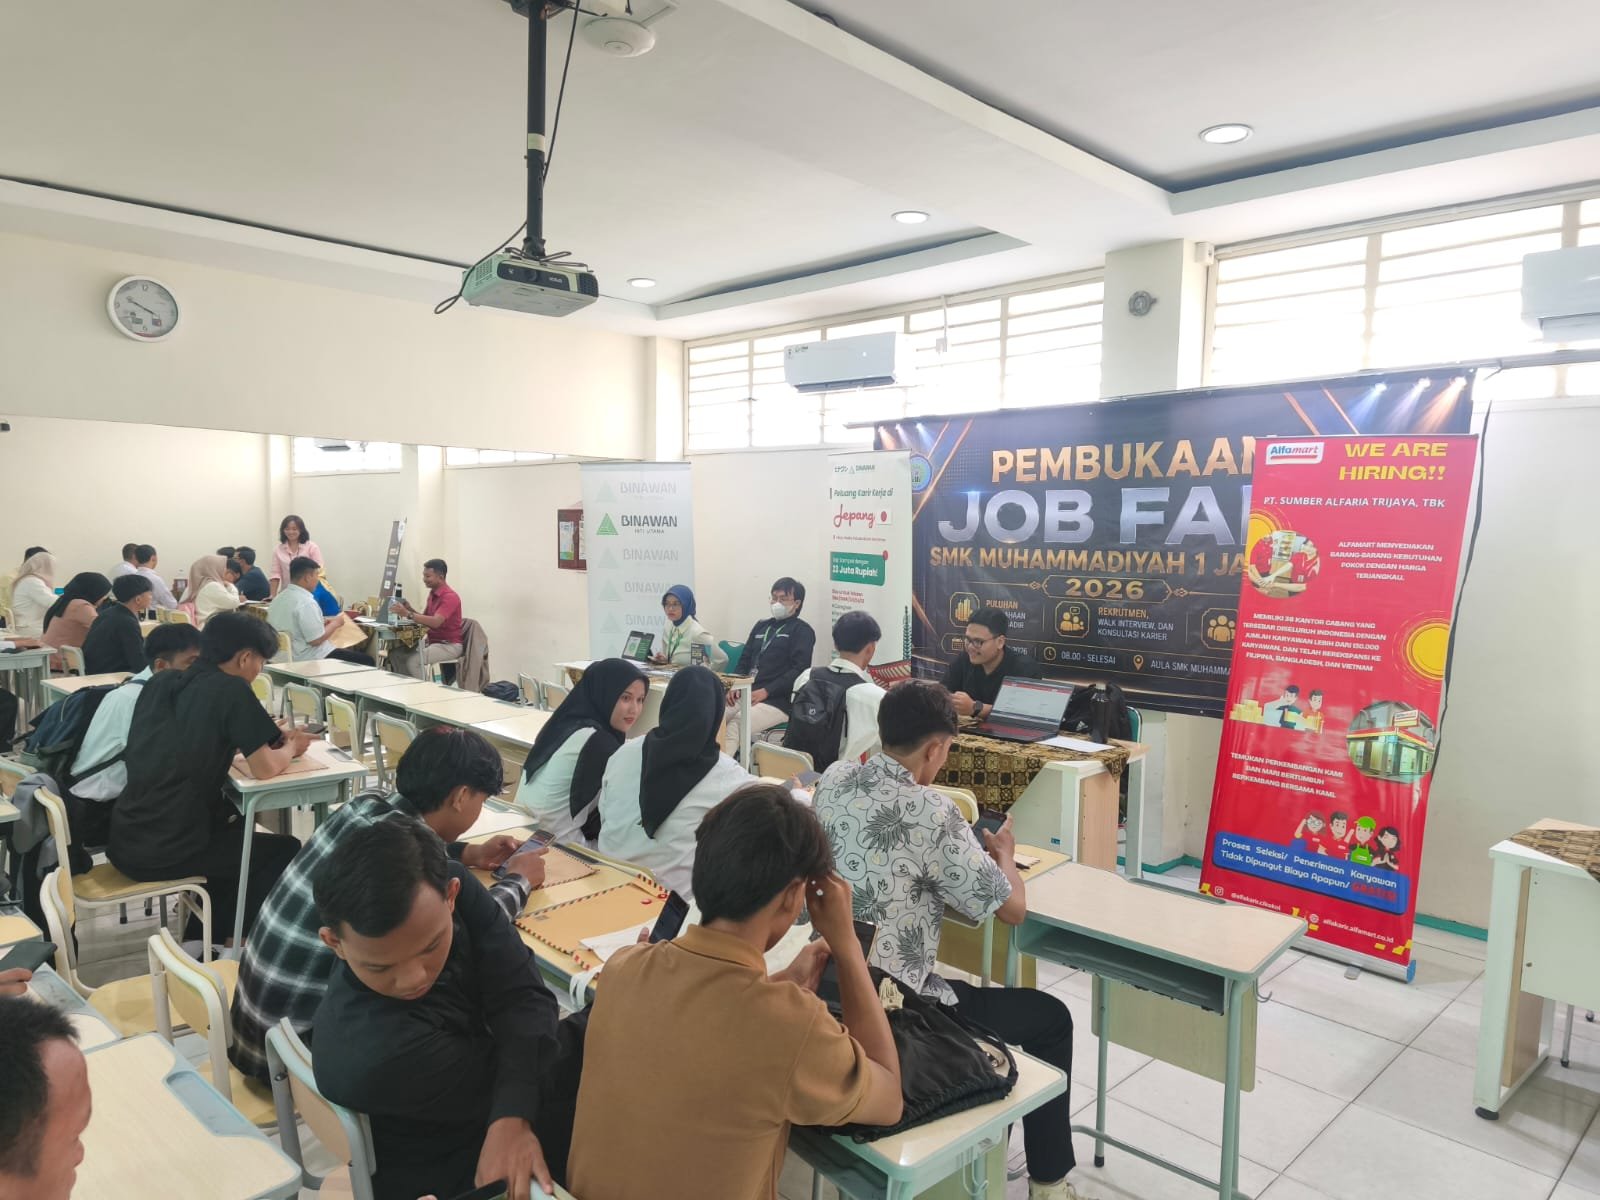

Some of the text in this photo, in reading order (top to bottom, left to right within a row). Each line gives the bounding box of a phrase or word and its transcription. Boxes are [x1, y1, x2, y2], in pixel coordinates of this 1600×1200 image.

[1270, 444, 1319, 455] Alfamart
[1344, 442, 1448, 458] WE ARE
[1339, 466, 1446, 480] HIRING!!
[620, 482, 676, 494] BINAWAN
[1263, 496, 1446, 508] PT. SUMBER ALFARIA TRIJAYA, TBK
[621, 514, 678, 528] BINAWAN
[834, 503, 876, 528] Jepang
[937, 489, 1095, 544] JOB
[1338, 541, 1434, 550] ALFAMART MENYEDIAKAN
[623, 549, 679, 561] BINAWAN
[929, 546, 973, 568] SMK
[979, 548, 1186, 575] MUHAMMADIYAH
[1195, 554, 1205, 575] 1
[1330, 551, 1443, 562] BARANG-BARANG KEBUTUHAN
[840, 566, 855, 574] Juta
[1366, 562, 1397, 570] DENGAN
[1398, 564, 1427, 572] HARGA
[1064, 577, 1144, 600] 2026
[986, 600, 1018, 609] PULUHAN
[1098, 607, 1150, 620] REKRUTMEN,
[1098, 618, 1174, 632] WALK INTERVIEW, DAN
[1295, 616, 1324, 626] KANTOR
[1326, 619, 1355, 628] CABANG
[1098, 628, 1168, 641] KONSULTASI KARIER
[1242, 622, 1386, 641] TERSEBAR DISELURUH INDONESIA DENGAN
[1272, 635, 1313, 645] KARYAWAN
[1314, 639, 1334, 647] LEBIH
[1335, 641, 1352, 649] DARI
[1061, 651, 1081, 661] 08.00
[1087, 654, 1116, 665] SELESAI
[1299, 647, 1322, 656] TELAH
[1151, 660, 1170, 670] AULA
[1172, 662, 1189, 672] SMK
[1325, 660, 1341, 668] DAN
[1341, 662, 1374, 672] VIETNAM
[1231, 752, 1344, 778] TEMUKAN PERKEMBANGAN KAMI
[1246, 765, 1324, 785] DAN MARI BERTUMBUH
[1232, 772, 1280, 787] BERKEMBANG
[1280, 782, 1315, 794] BERSAMA
[1221, 850, 1244, 862] Tidak
[1245, 855, 1283, 872] Dipungut
[1284, 865, 1309, 880] Biaya
[1311, 872, 1350, 889] Apapun/
[1222, 838, 1397, 889] Proses Seleksi/ Penerimaan Karyawan
